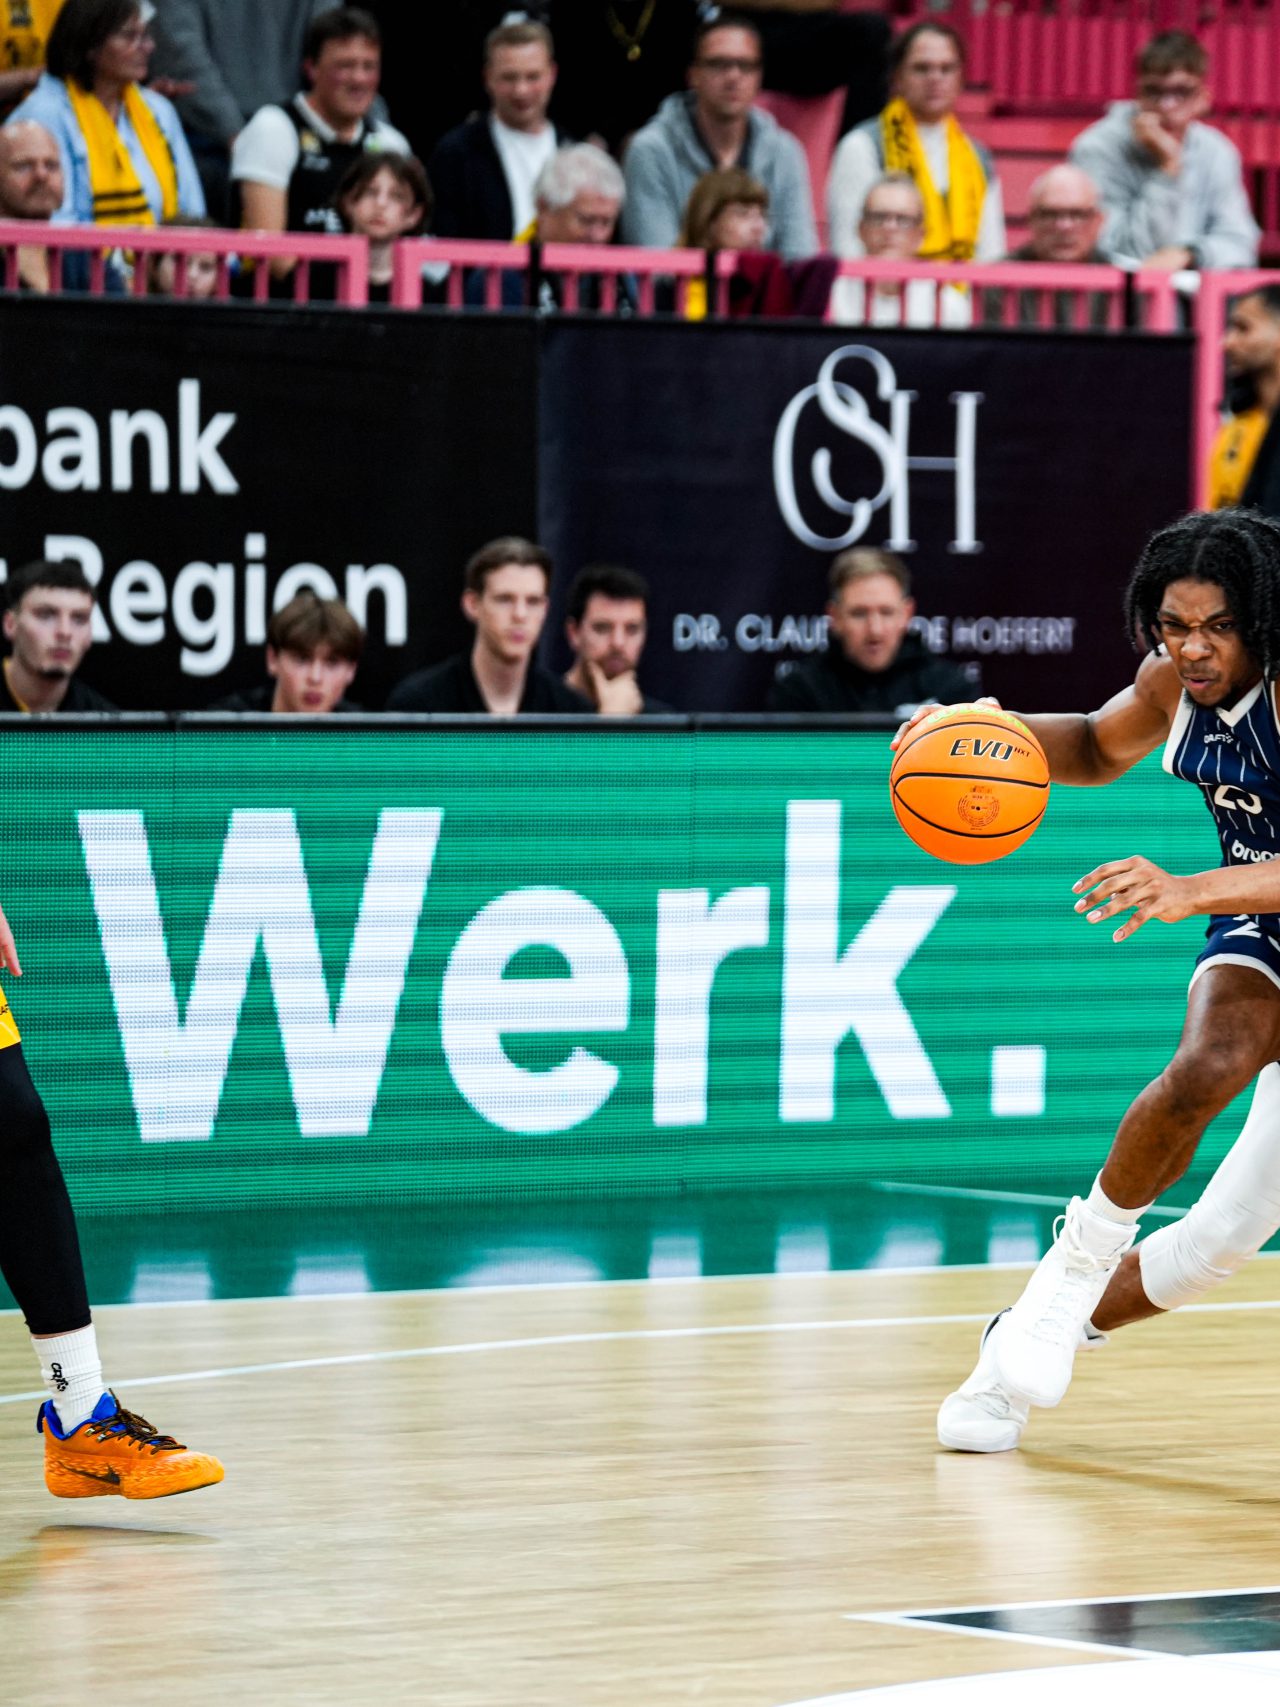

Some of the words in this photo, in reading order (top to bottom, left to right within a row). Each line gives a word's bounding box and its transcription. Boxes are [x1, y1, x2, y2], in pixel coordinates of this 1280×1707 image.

[673, 613, 729, 652] DR.
[950, 738, 1014, 761] EVO
[76, 800, 1047, 1142] Werk.
